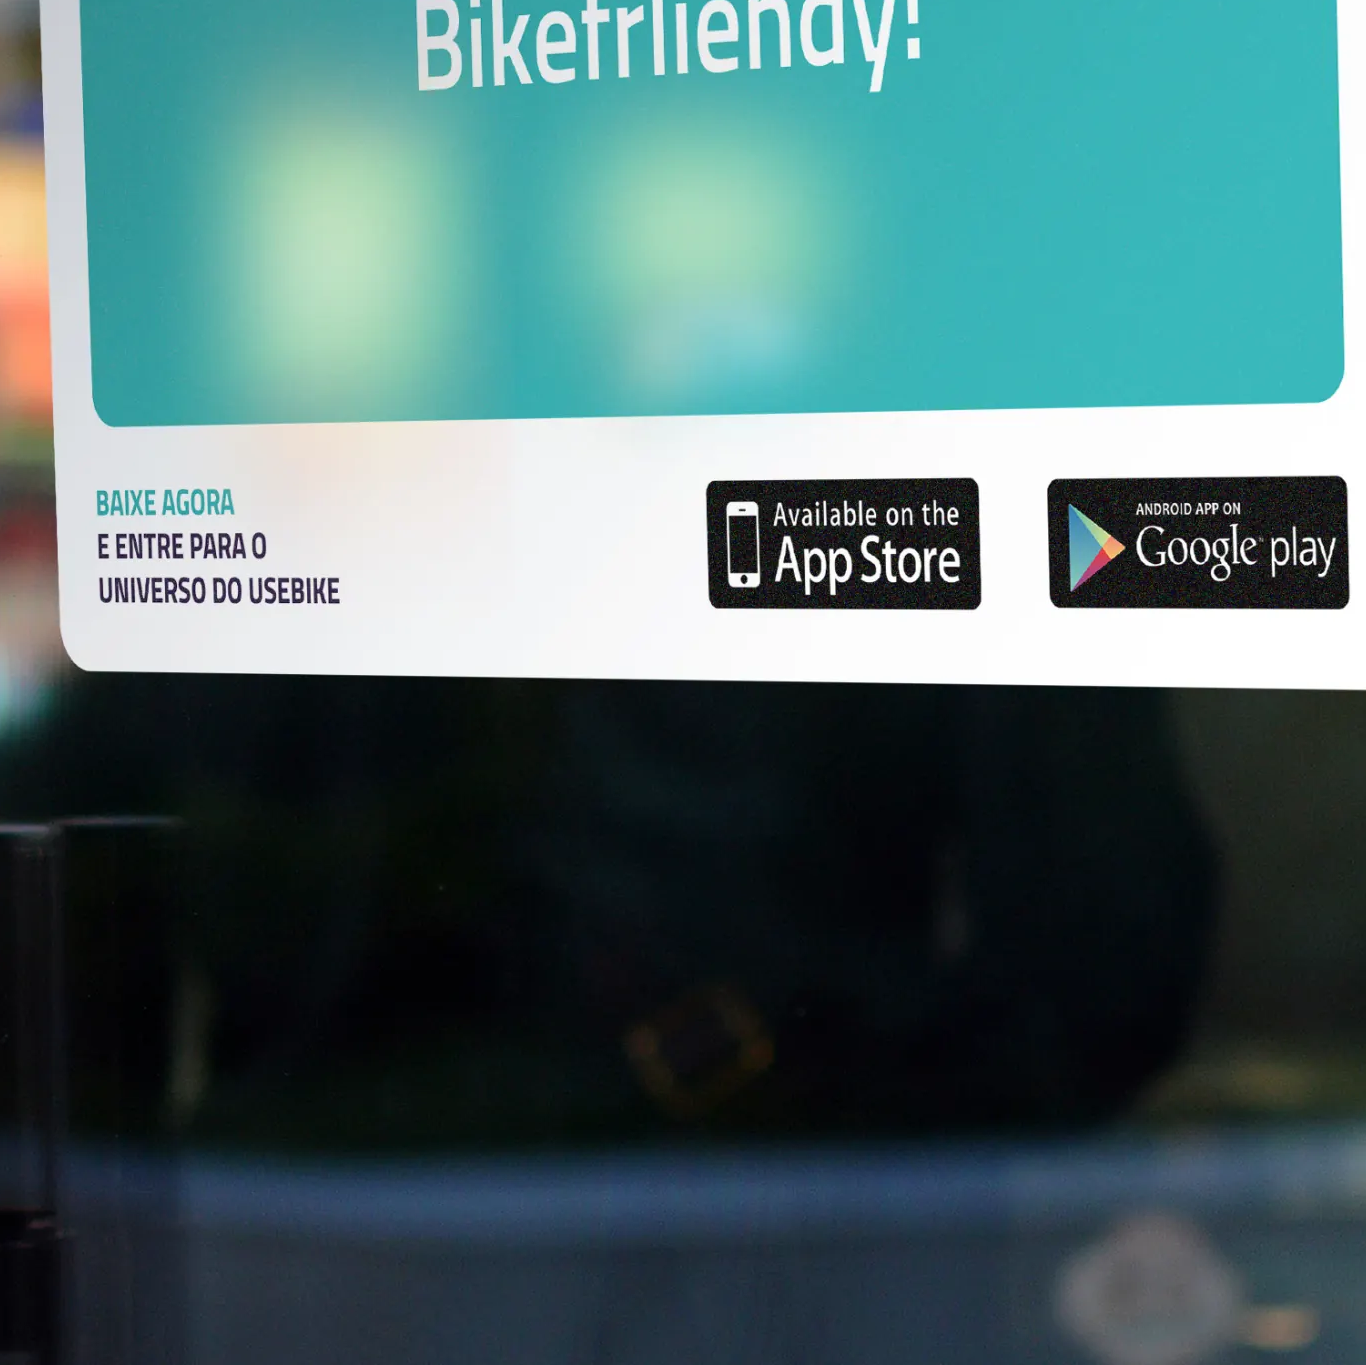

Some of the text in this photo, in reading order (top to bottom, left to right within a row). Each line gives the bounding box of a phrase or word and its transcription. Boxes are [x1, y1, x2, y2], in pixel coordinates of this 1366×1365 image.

[96, 488, 235, 516] BAIXE AGORA
[773, 499, 960, 527] Available on the
[1136, 502, 1241, 516] ANDROID APP ON
[97, 532, 267, 560] E ENTRE PARA O
[1270, 525, 1337, 578] play
[774, 534, 961, 596] App Store
[99, 576, 340, 604] UNIVERSO DO USEBIKE
